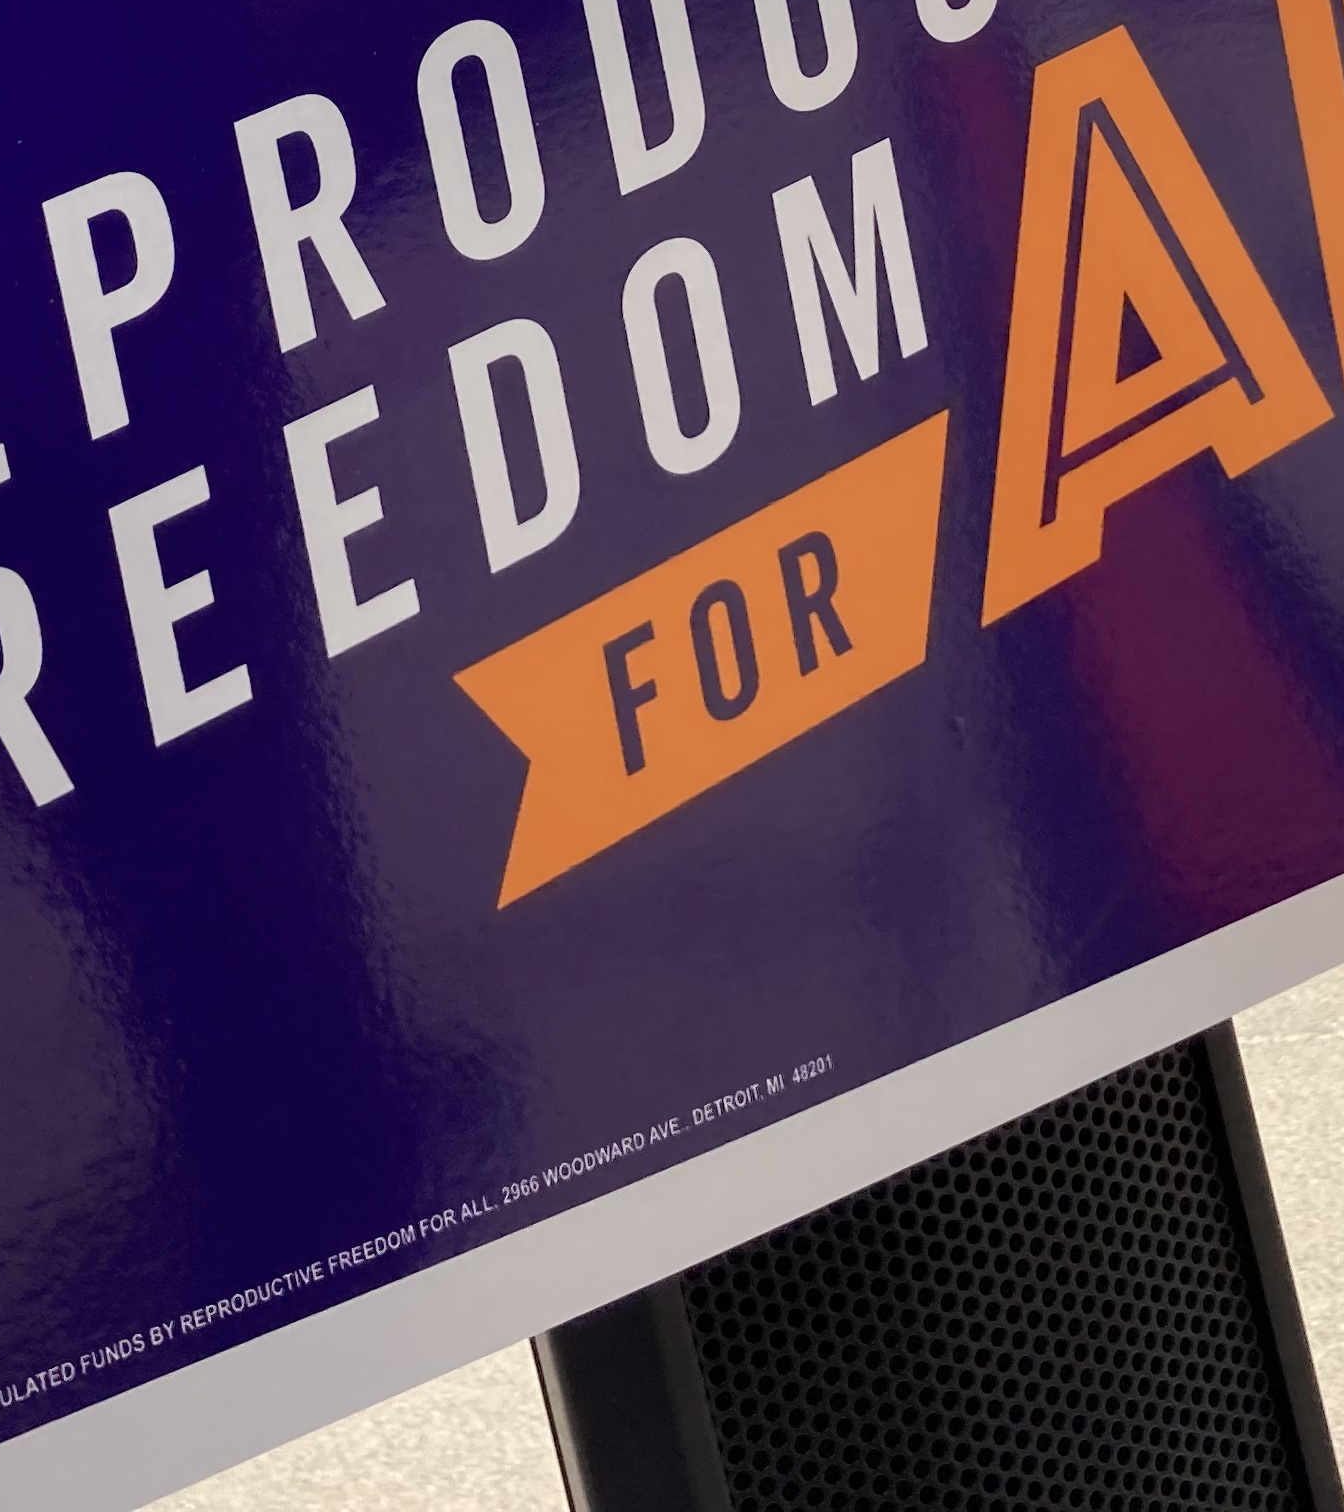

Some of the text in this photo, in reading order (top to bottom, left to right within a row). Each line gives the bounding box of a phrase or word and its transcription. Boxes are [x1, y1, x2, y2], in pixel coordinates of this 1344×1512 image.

[602, 530, 854, 777] FOR
[79, 1333, 145, 1375] FUNDS
[149, 1319, 176, 1347] BY
[179, 1260, 325, 1334] REPRODUCTIVE
[327, 1224, 417, 1275] FREEDOM
[417, 1207, 459, 1238] FOR
[501, 1174, 540, 1205] 2966
[541, 1131, 646, 1187] WOODWARD
[765, 1072, 787, 1095] MI
[791, 1053, 833, 1084] 48201
